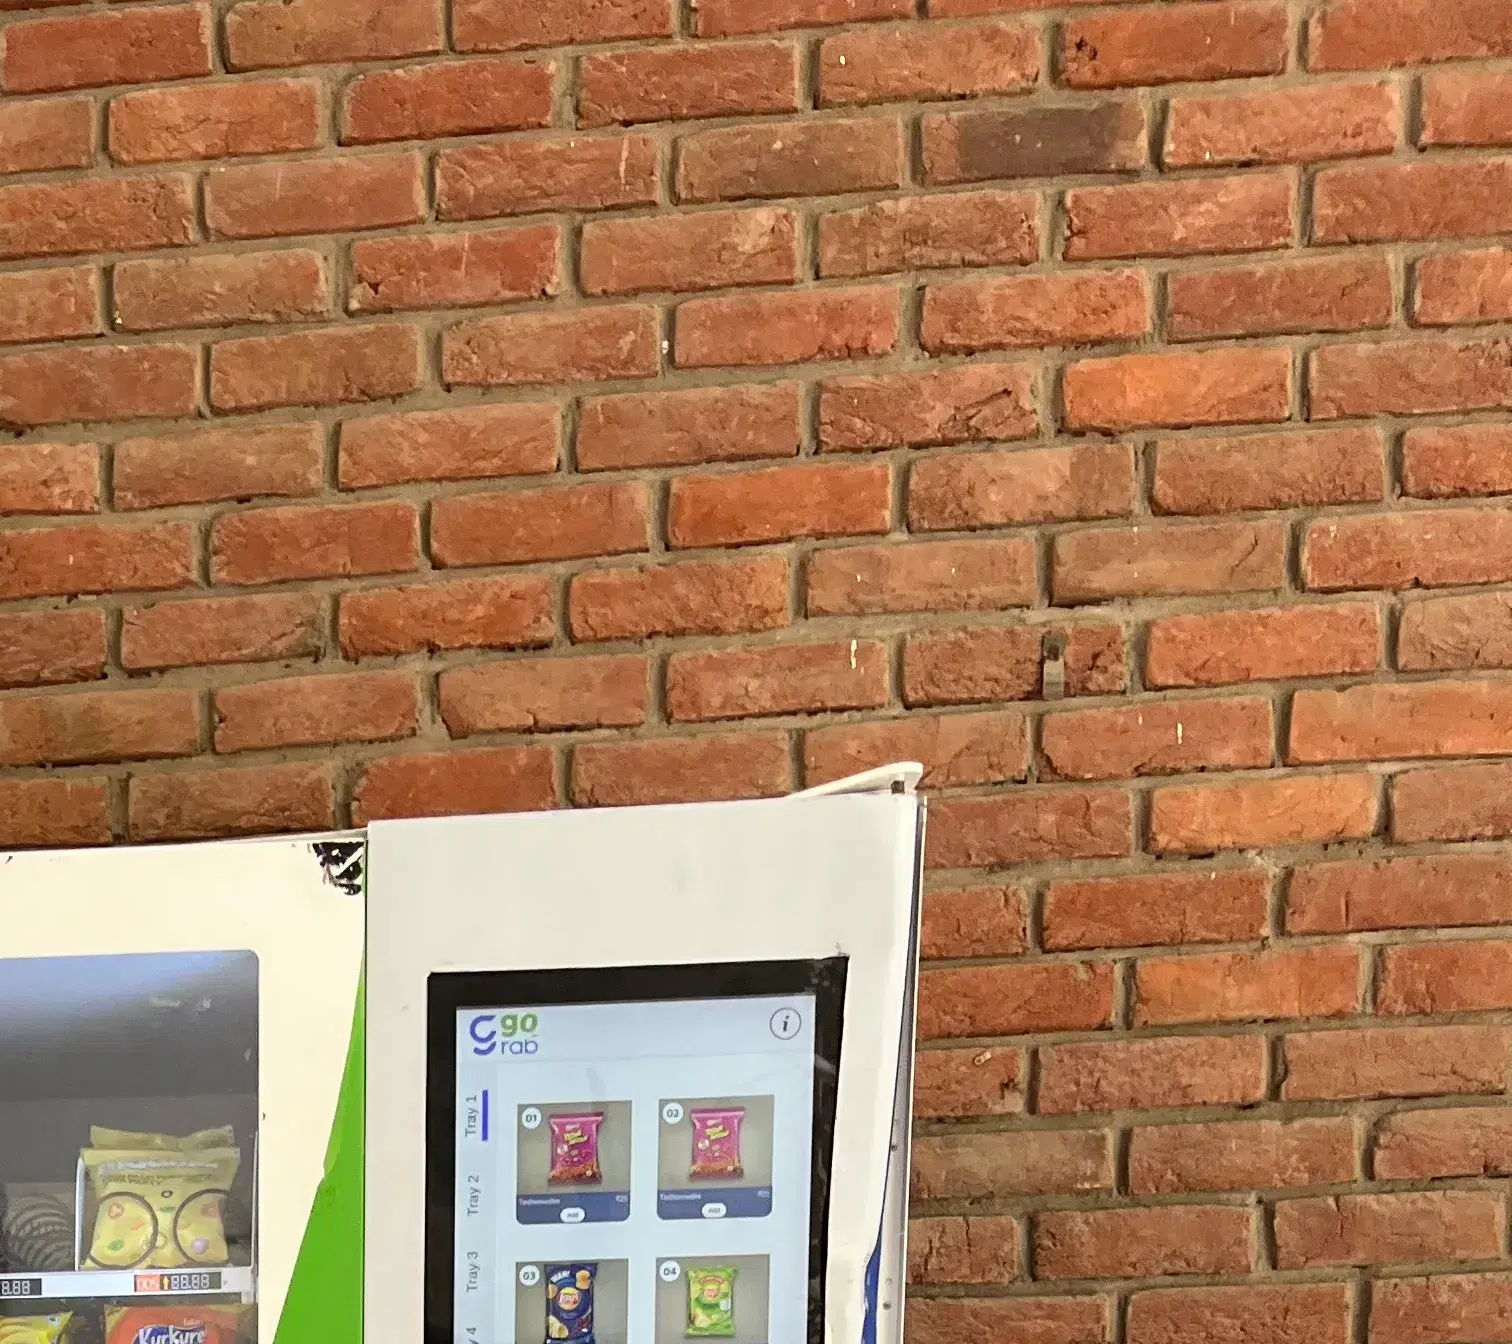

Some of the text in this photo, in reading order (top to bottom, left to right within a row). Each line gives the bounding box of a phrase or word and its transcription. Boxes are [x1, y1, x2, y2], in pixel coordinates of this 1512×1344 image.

[465, 1108, 479, 1137] Tray
[468, 1186, 482, 1215] Tray
[466, 1263, 480, 1292] Tray
